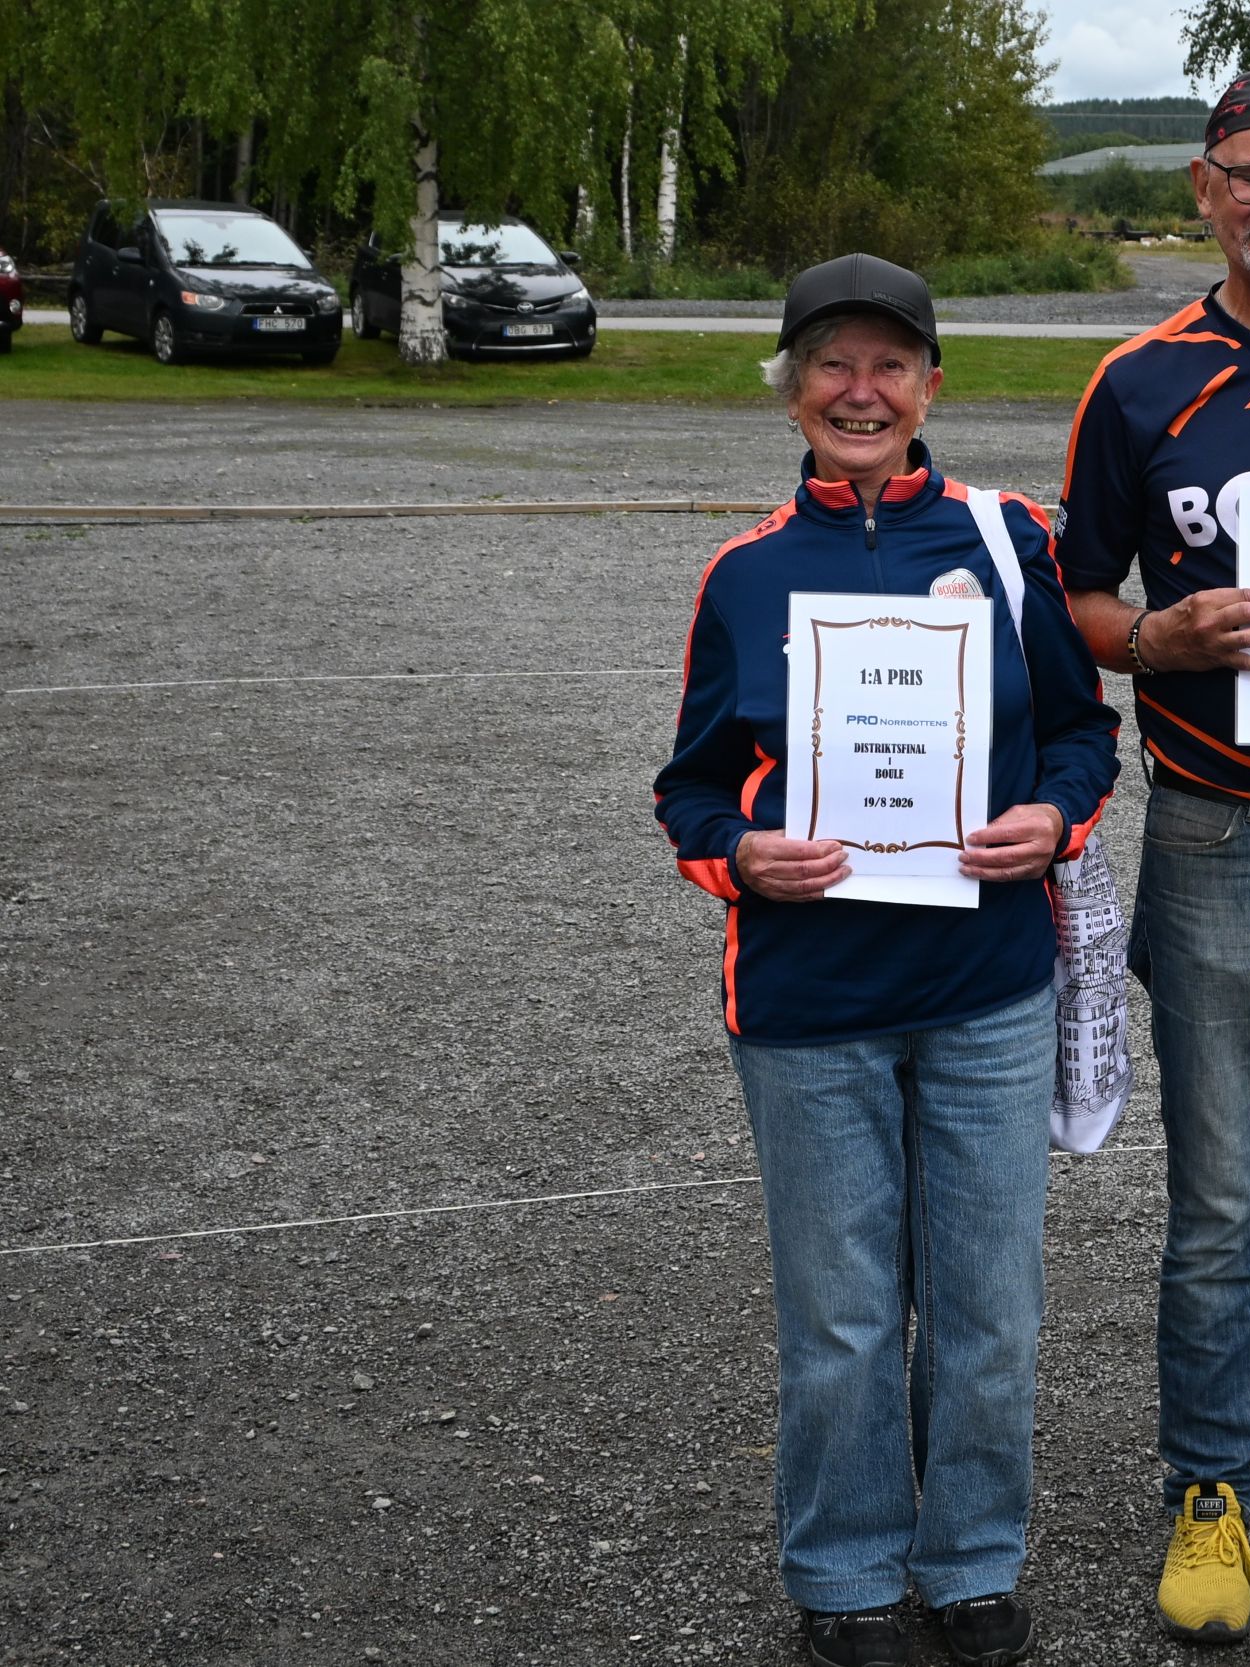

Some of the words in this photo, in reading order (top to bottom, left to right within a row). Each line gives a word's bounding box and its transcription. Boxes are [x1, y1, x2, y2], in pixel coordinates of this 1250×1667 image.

[936, 582, 969, 596] BODENS
[859, 667, 883, 685] 1:A
[888, 668, 923, 686] PRIS
[846, 714, 879, 726] PRO
[853, 742, 927, 755] DISTRIKTSFINAL
[875, 768, 904, 780] BOULE
[863, 796, 888, 809] 19/8
[889, 797, 914, 809] 2026
